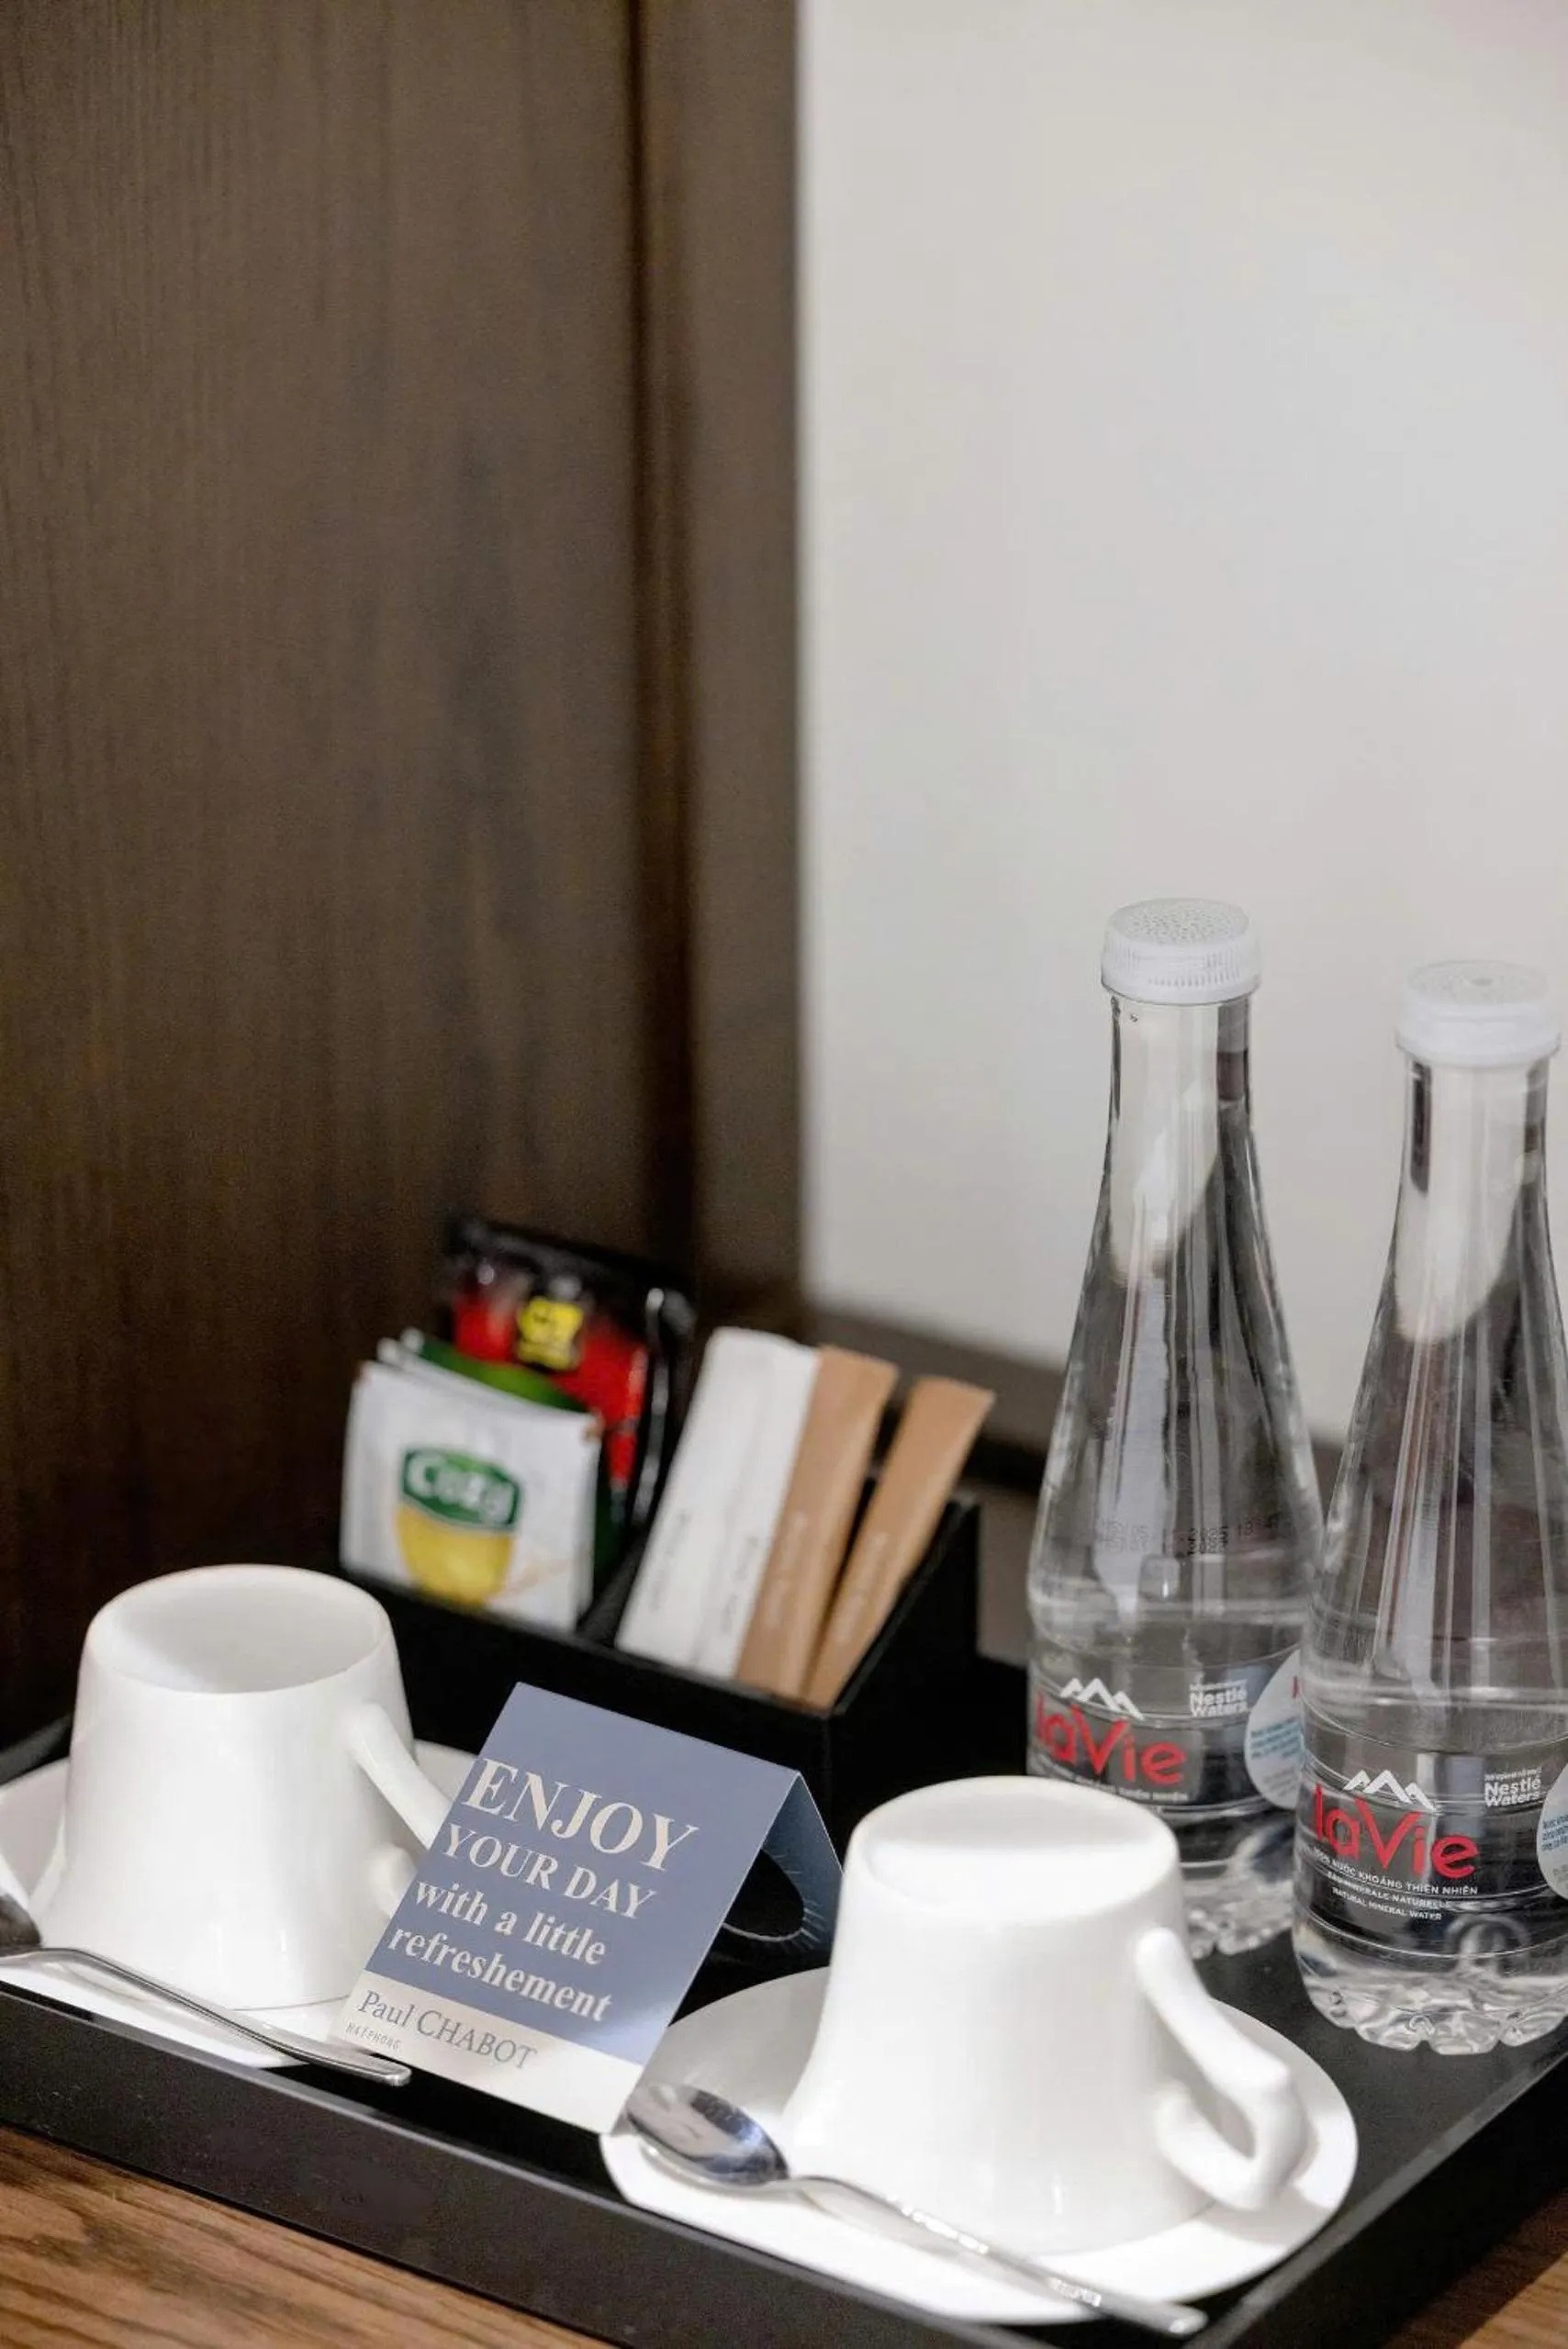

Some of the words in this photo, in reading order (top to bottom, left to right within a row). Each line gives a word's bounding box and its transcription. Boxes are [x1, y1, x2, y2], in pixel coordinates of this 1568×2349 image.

[461, 1758, 700, 1872] ENJOY
[1484, 1774, 1541, 1796] Nestlé
[1484, 1791, 1540, 1807] Waters
[442, 1824, 559, 1890] YOUR
[564, 1864, 656, 1919] DAY
[1442, 1885, 1478, 1896] NHIÊN
[415, 1880, 488, 1925] with
[495, 1910, 518, 1936] a
[522, 1912, 607, 1966] little
[1410, 1909, 1442, 1920] WATER
[387, 1927, 613, 2022] refreshement
[358, 1990, 415, 2028] Paul
[417, 2009, 538, 2068] CHABOT
